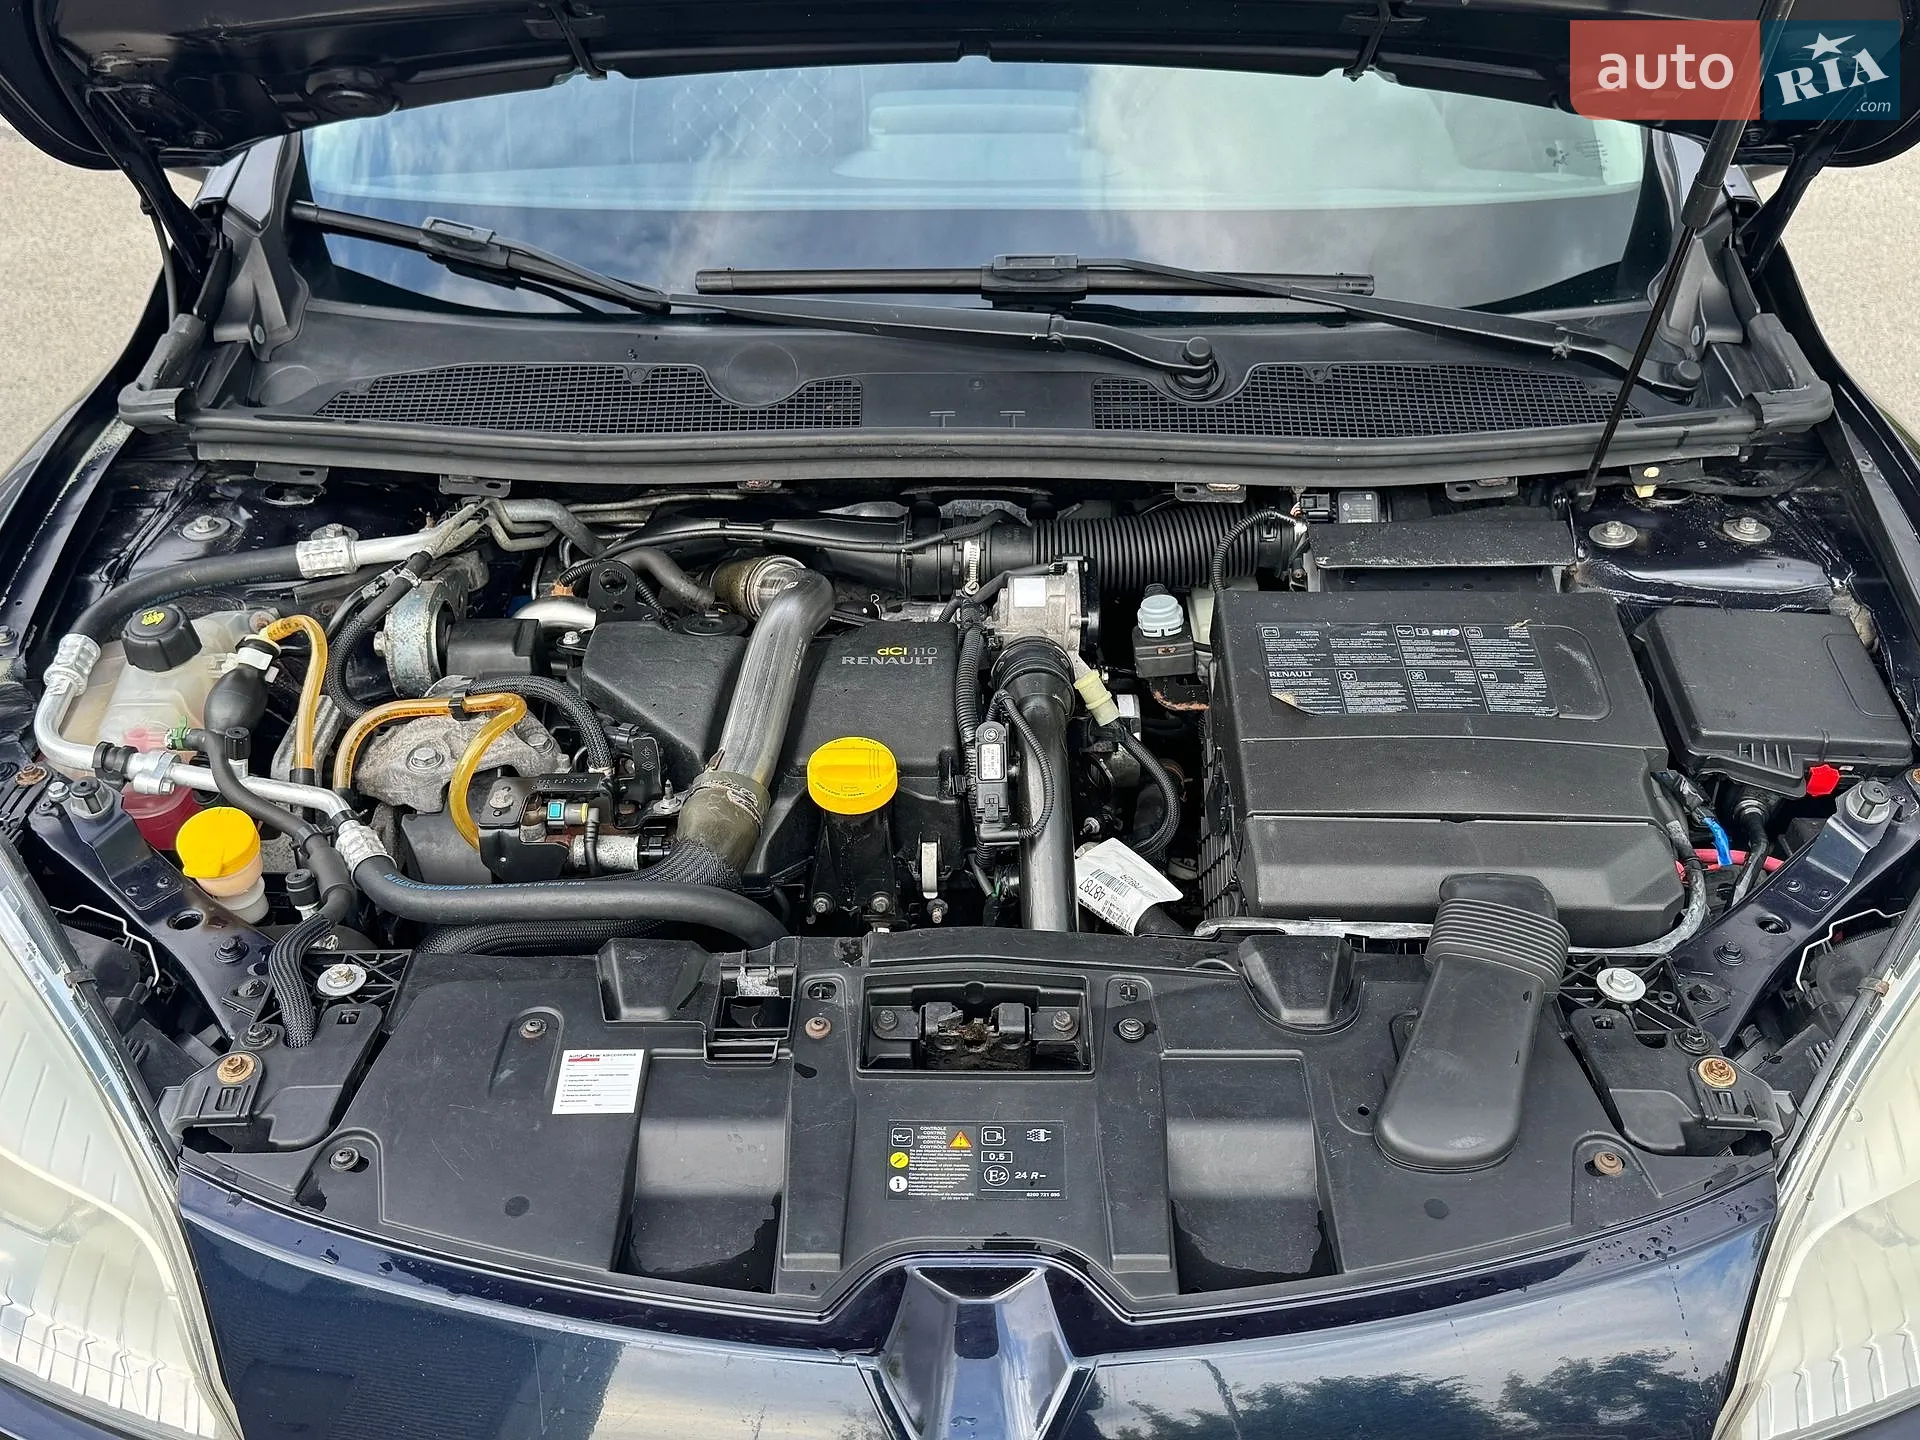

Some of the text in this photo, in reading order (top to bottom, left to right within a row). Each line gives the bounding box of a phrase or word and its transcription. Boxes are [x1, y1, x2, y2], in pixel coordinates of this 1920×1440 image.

[913, 647, 938, 655] 110
[841, 656, 938, 665] RENAULT
[988, 1153, 1005, 1162] 0,5
[988, 1169, 1007, 1182] E2
[1014, 1171, 1028, 1180] 24
